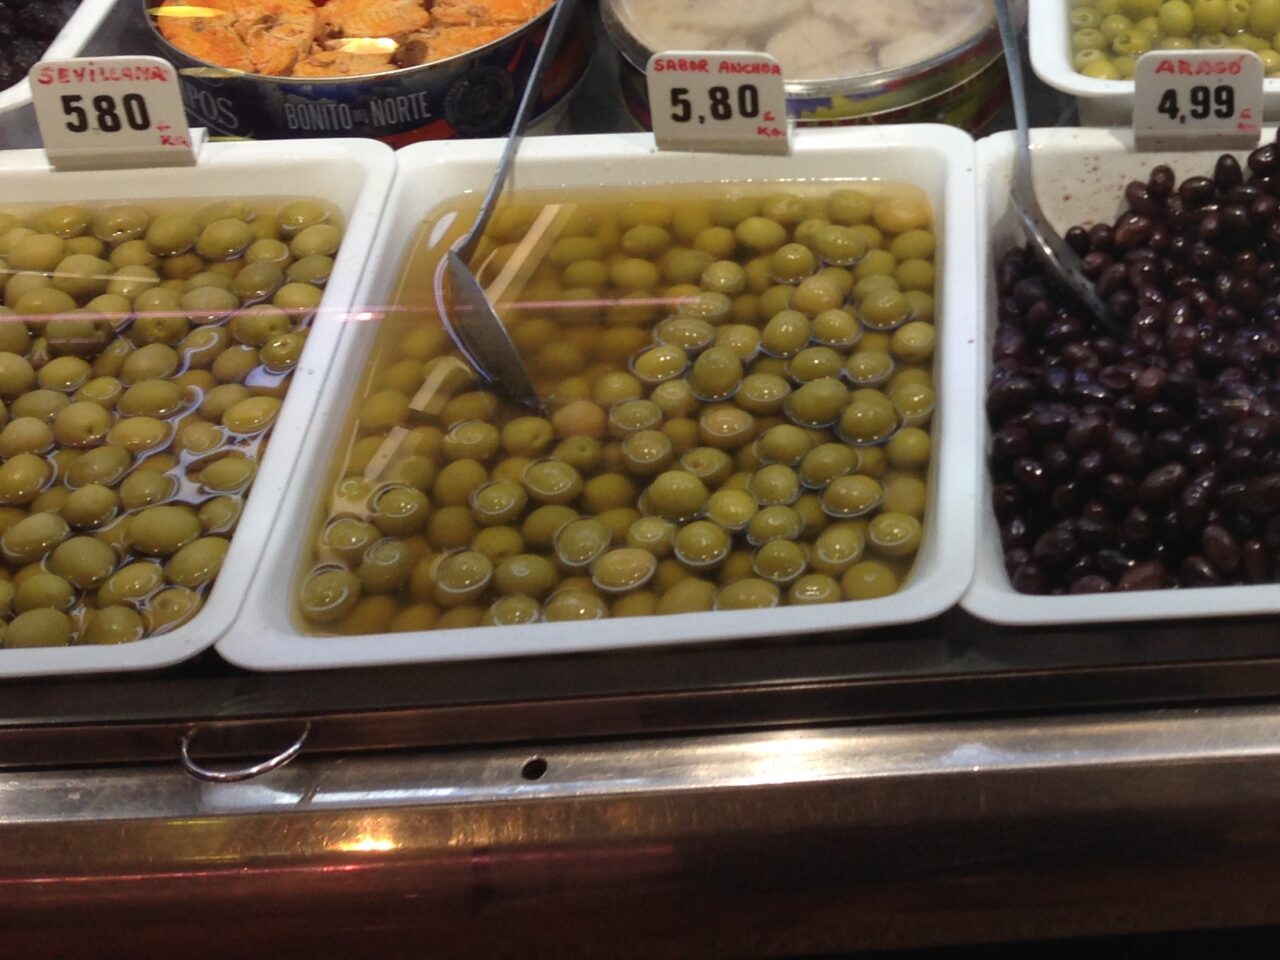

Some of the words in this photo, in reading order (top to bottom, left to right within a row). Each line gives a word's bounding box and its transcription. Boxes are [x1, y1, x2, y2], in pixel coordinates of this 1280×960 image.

[653, 58, 709, 74] SABOR
[718, 60, 783, 76] ANCHOA
[283, 102, 353, 131] BONITO
[369, 90, 432, 128] NORTE
[669, 84, 759, 125] 5,80
